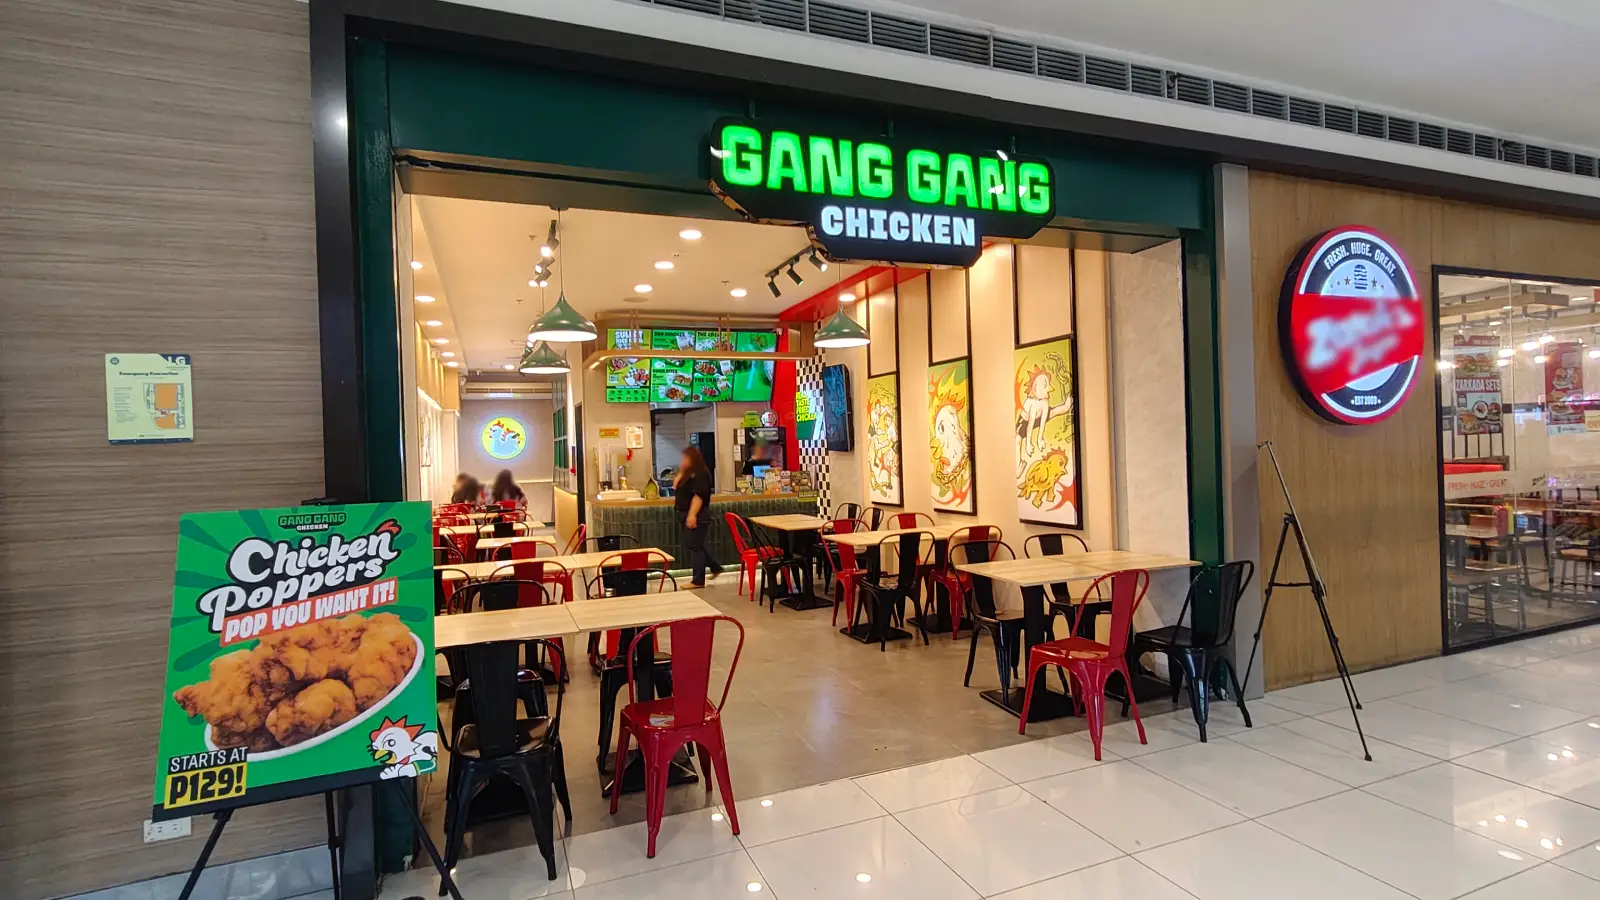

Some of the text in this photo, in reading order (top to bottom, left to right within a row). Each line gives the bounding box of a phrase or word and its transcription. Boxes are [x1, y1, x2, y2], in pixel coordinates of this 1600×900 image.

[721, 125, 1051, 214] GANG GANG
[820, 205, 976, 247] CHICKEN
[1323, 242, 1397, 277] FRESH. HUGE. GREAT.
[168, 355, 186, 365] LG
[1456, 378, 1501, 391] ZARKADA SETS
[279, 513, 346, 525] GANG GANG
[296, 523, 329, 531] CHICKEN
[230, 532, 398, 583] Chicken
[200, 558, 383, 631] Poppers
[224, 580, 396, 642] POP YOU WANT IT!
[170, 746, 248, 772] STARTS AT
[169, 765, 244, 805] P129!
